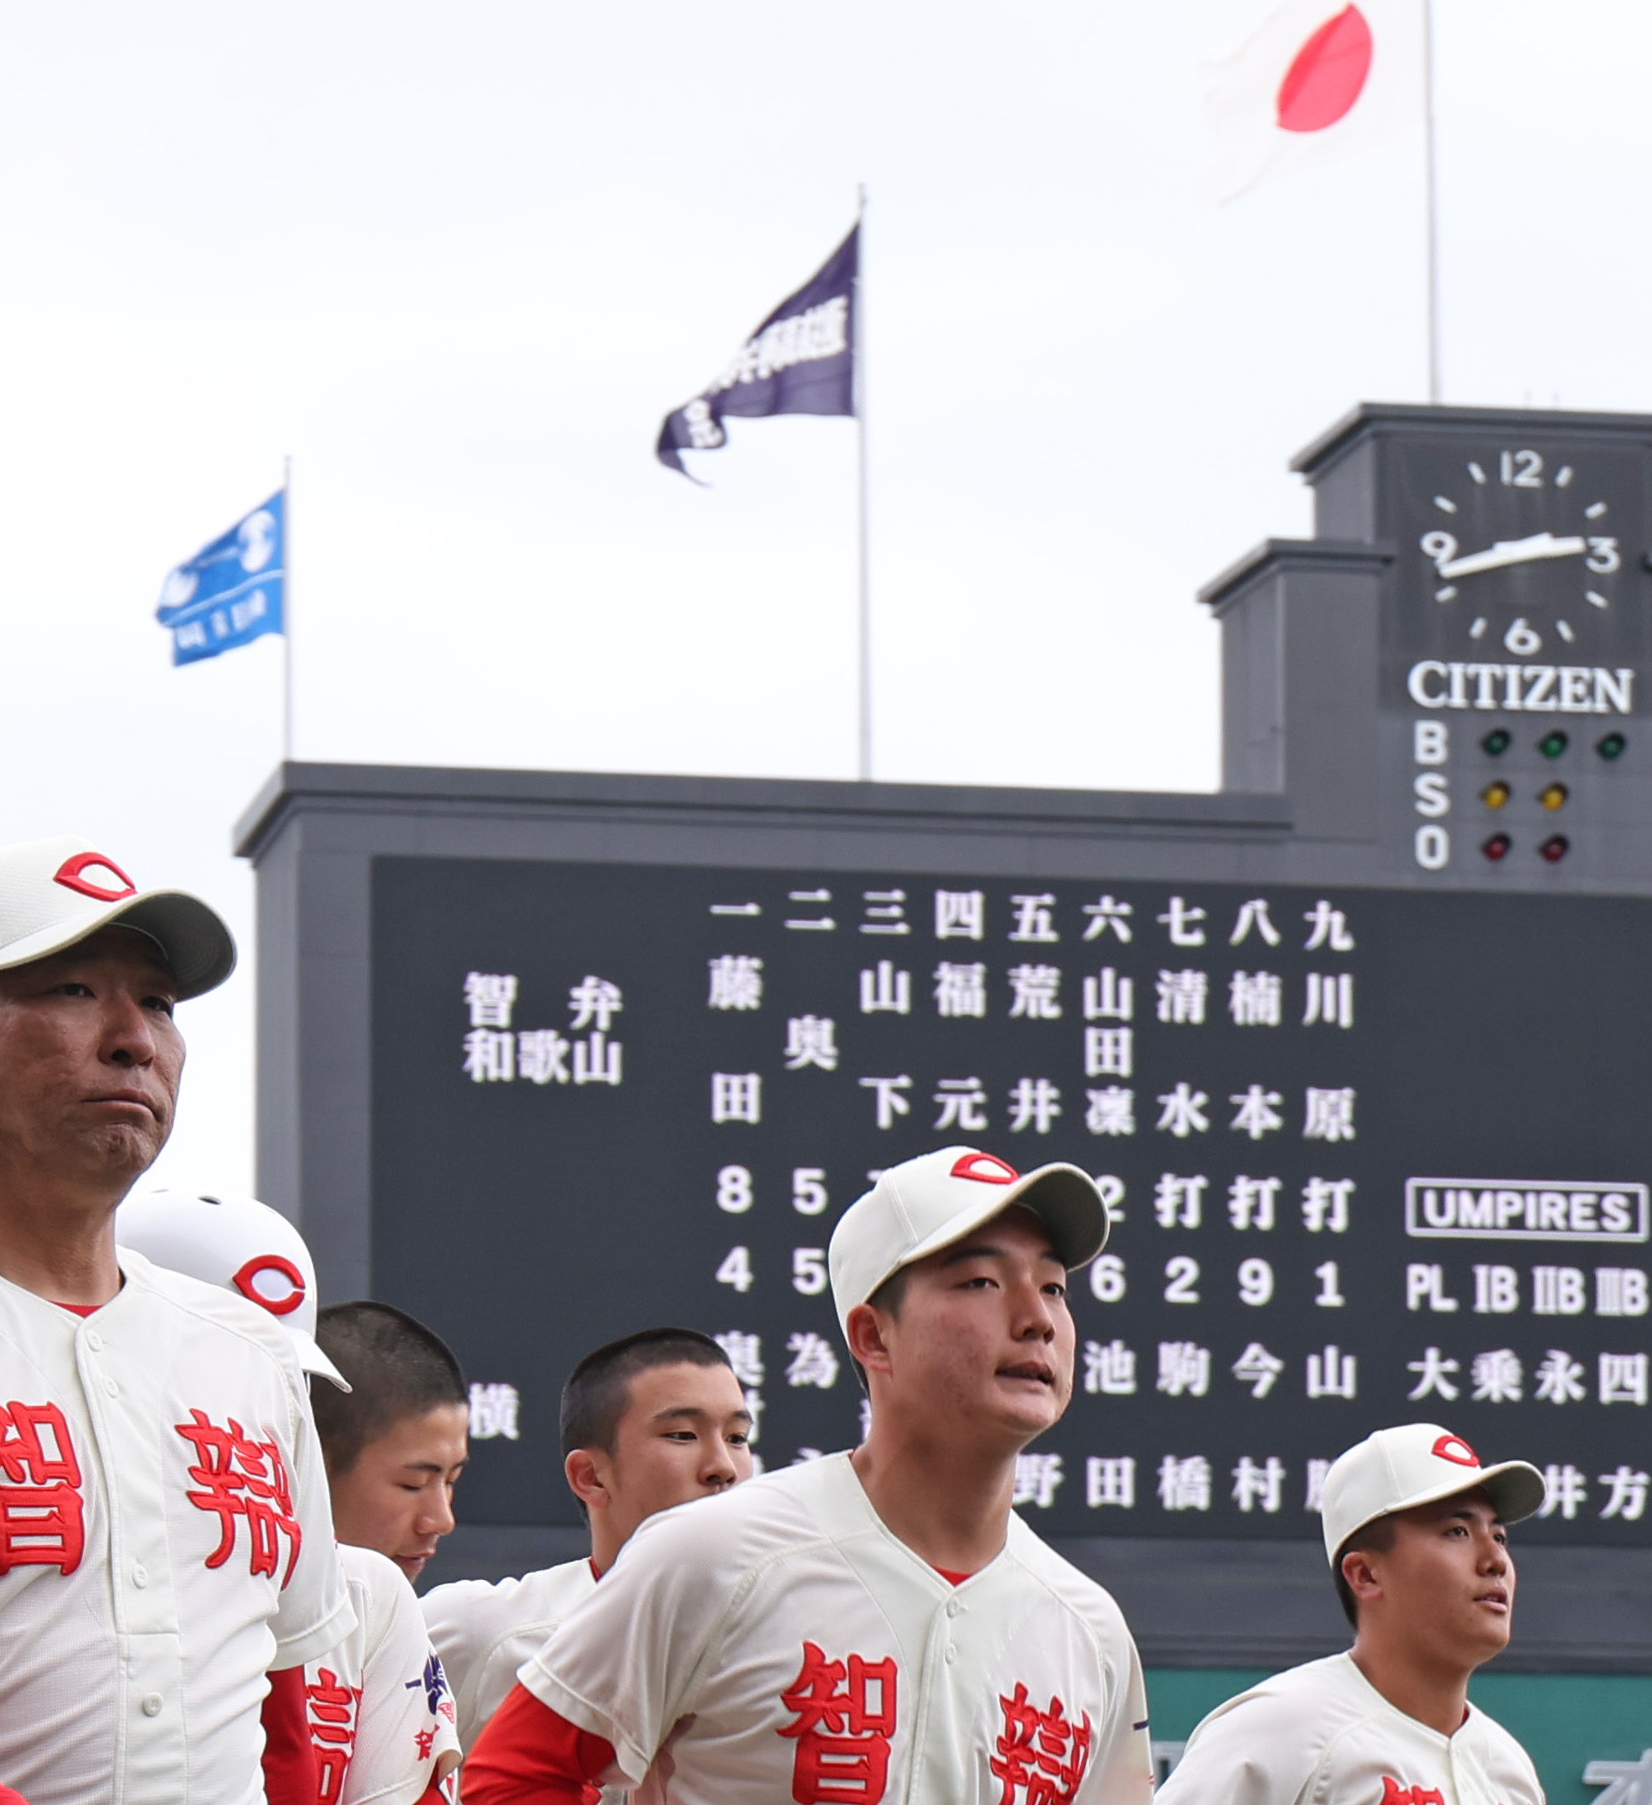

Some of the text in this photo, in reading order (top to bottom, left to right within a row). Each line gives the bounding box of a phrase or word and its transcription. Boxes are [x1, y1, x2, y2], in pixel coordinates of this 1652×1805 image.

[1500, 449, 1544, 489] 12
[1585, 536, 1621, 574] 3
[1504, 617, 1542, 656] 6
[1408, 660, 1634, 713] CITIZEN
[1414, 719, 1450, 766] B
[1414, 773, 1451, 818] S
[464, 1029, 623, 1085] 和歌山
[1423, 1187, 1632, 1235] UMPIRES
[1407, 1263, 1459, 1312] PL
